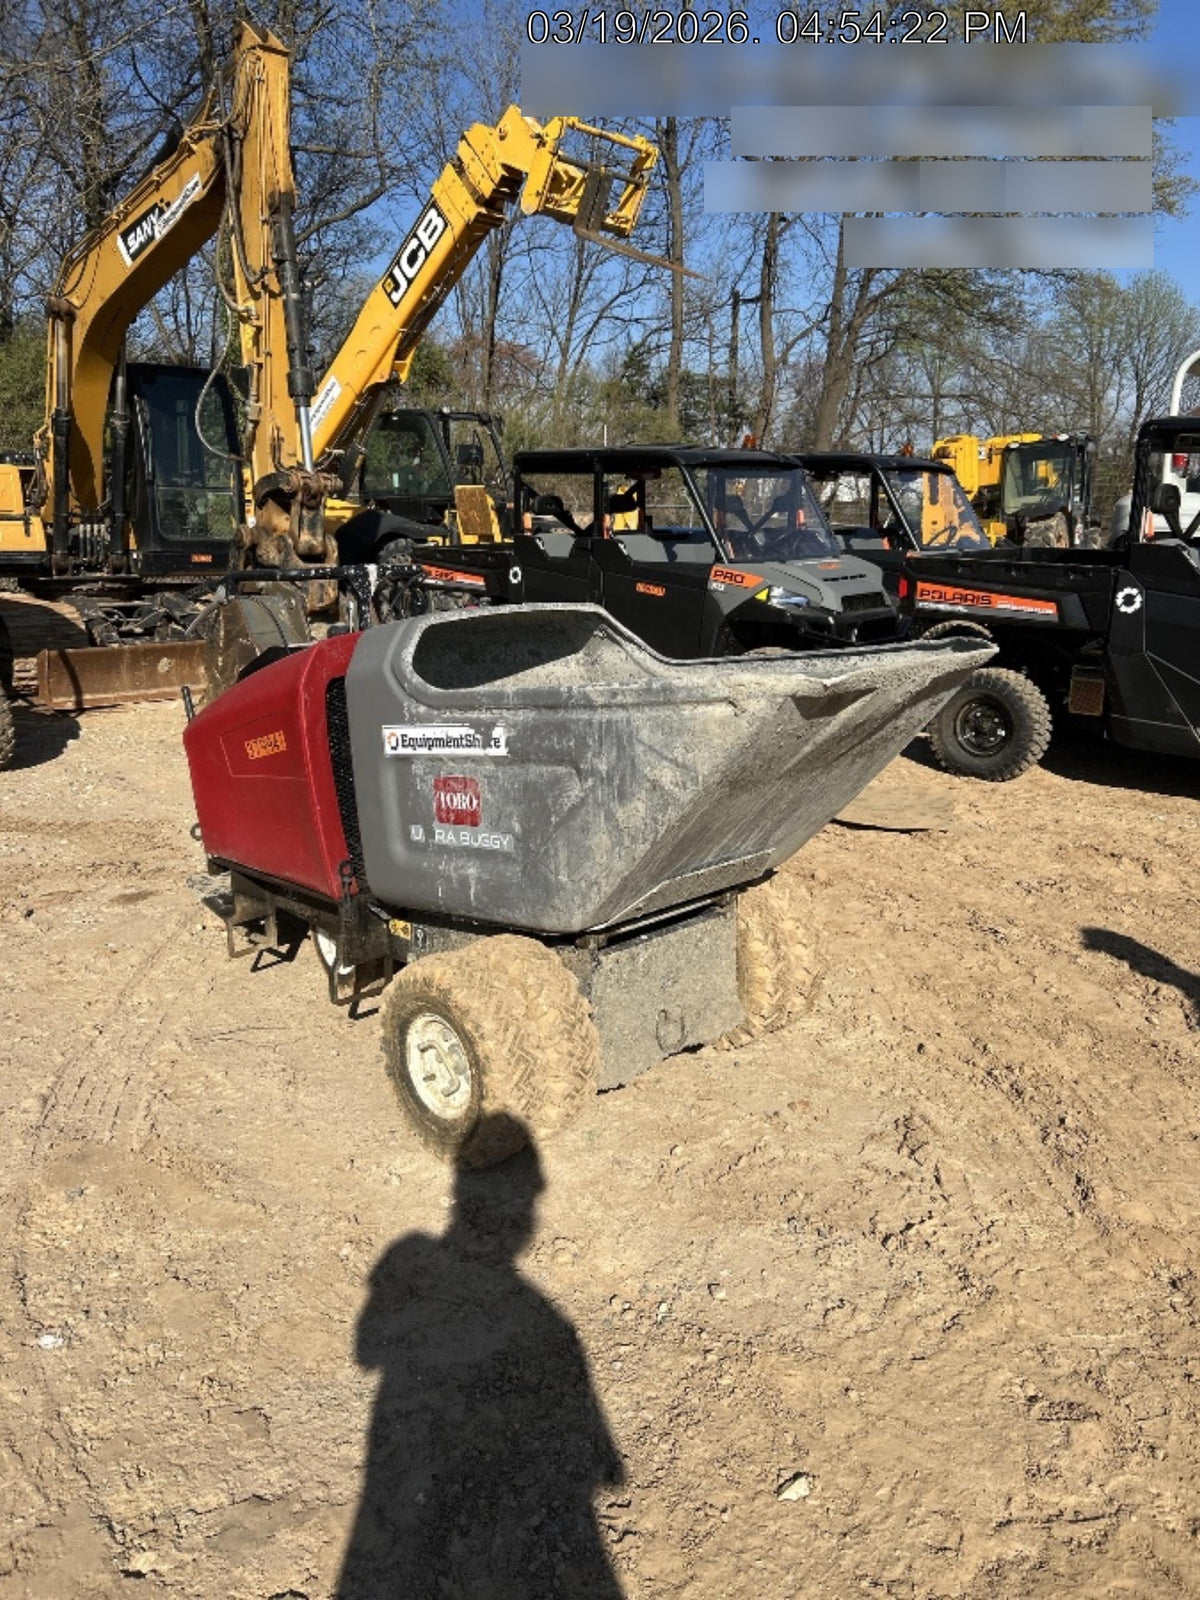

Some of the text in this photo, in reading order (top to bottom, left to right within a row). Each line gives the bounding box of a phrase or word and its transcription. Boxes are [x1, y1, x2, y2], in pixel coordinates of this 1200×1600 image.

[127, 207, 159, 254] SANY
[390, 207, 446, 303] JCB
[713, 568, 746, 584] PRO
[919, 588, 992, 605] POLARIS
[401, 733, 500, 751] EquipmentShre
[437, 792, 479, 811] TORO
[411, 826, 509, 849] URA BUGGY
